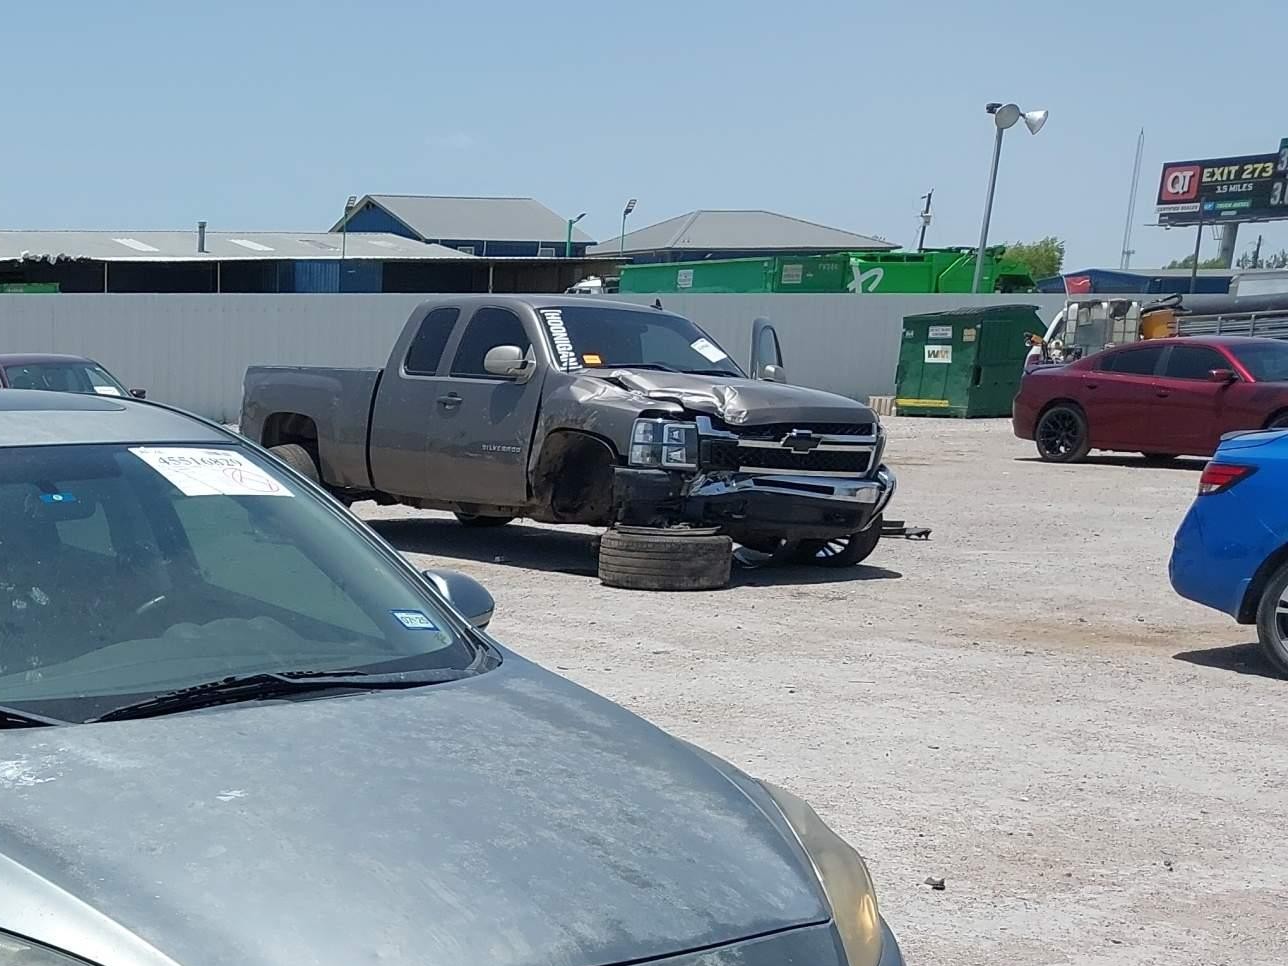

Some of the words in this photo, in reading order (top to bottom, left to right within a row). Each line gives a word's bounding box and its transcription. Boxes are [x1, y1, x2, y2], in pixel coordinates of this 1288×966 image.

[1202, 165, 1240, 182] EXIT
[1241, 162, 1274, 179] 273
[1167, 170, 1194, 195] QT
[1229, 183, 1253, 193] MILES
[927, 349, 949, 359] WM
[158, 456, 243, 468] 45516829
